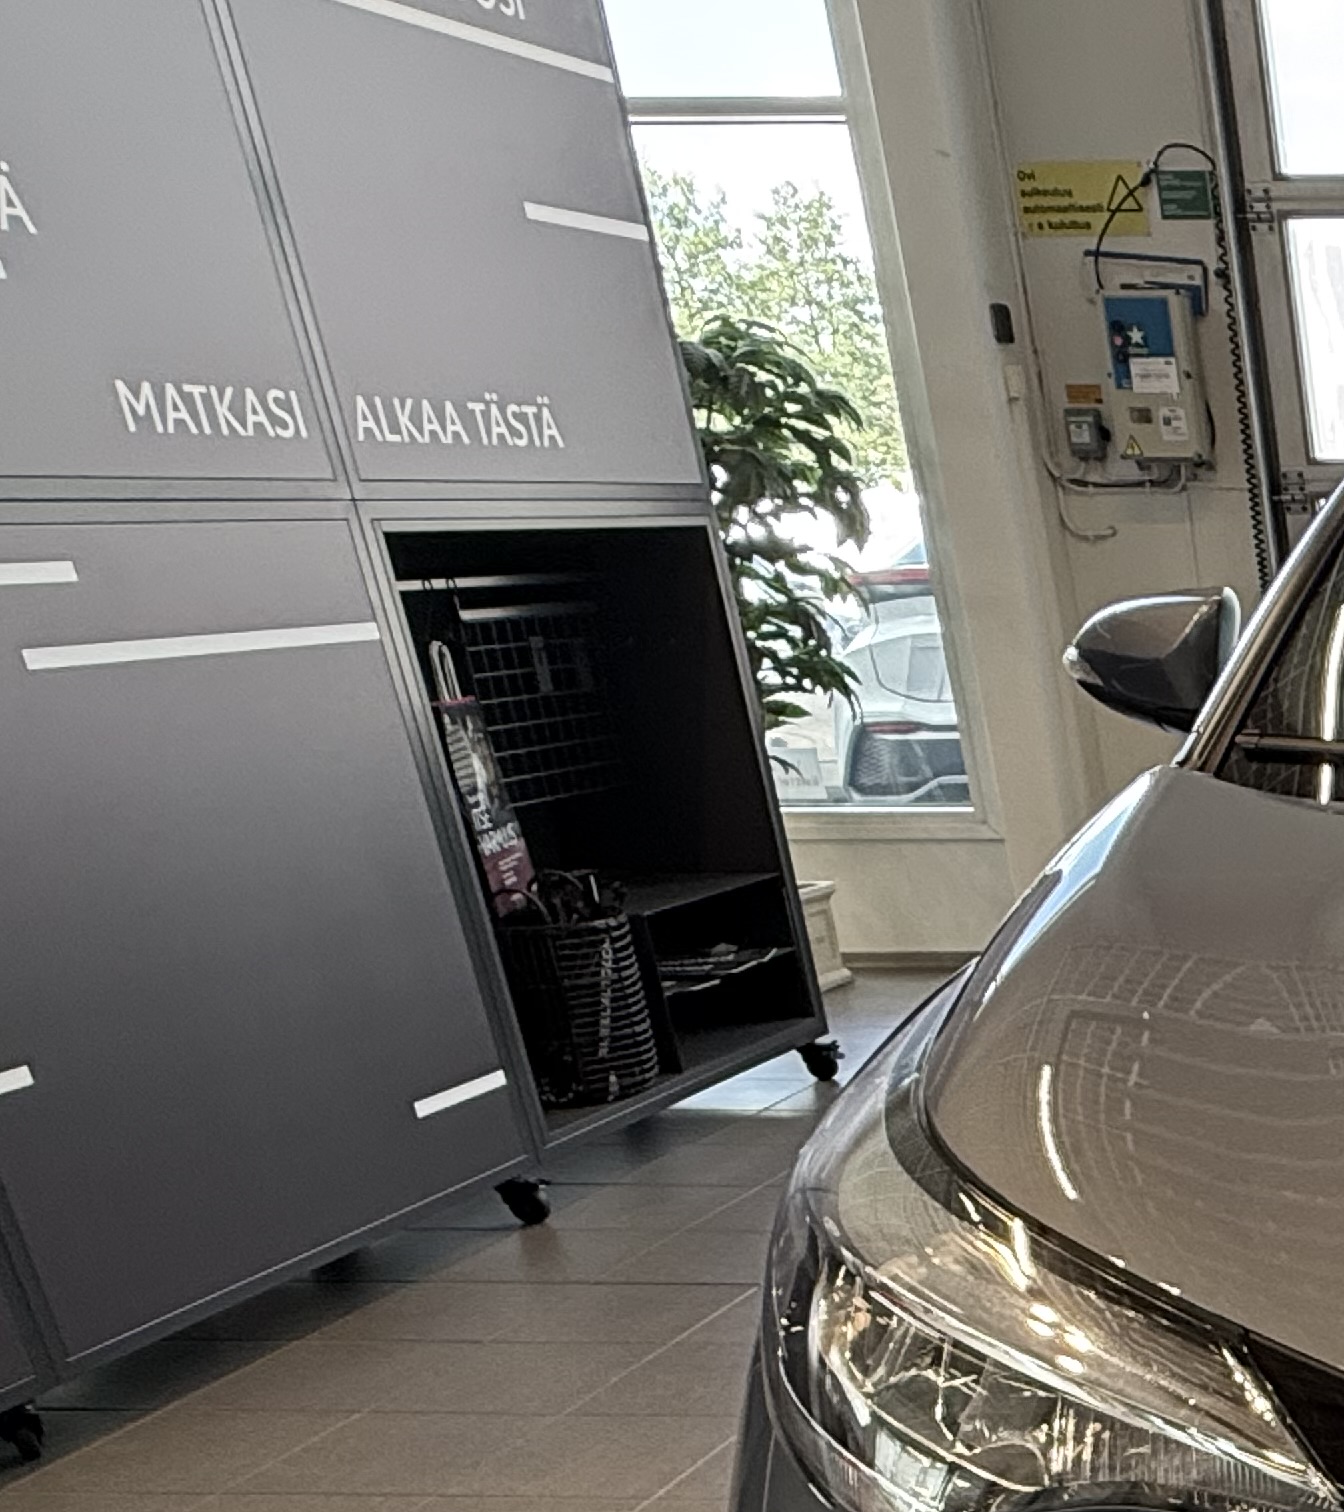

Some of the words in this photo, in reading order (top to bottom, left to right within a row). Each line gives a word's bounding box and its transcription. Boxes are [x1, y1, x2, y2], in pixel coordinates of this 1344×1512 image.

[115, 380, 307, 438] MATKASI
[356, 395, 468, 444] ALKAA
[467, 392, 564, 447] TÄSTÄ
